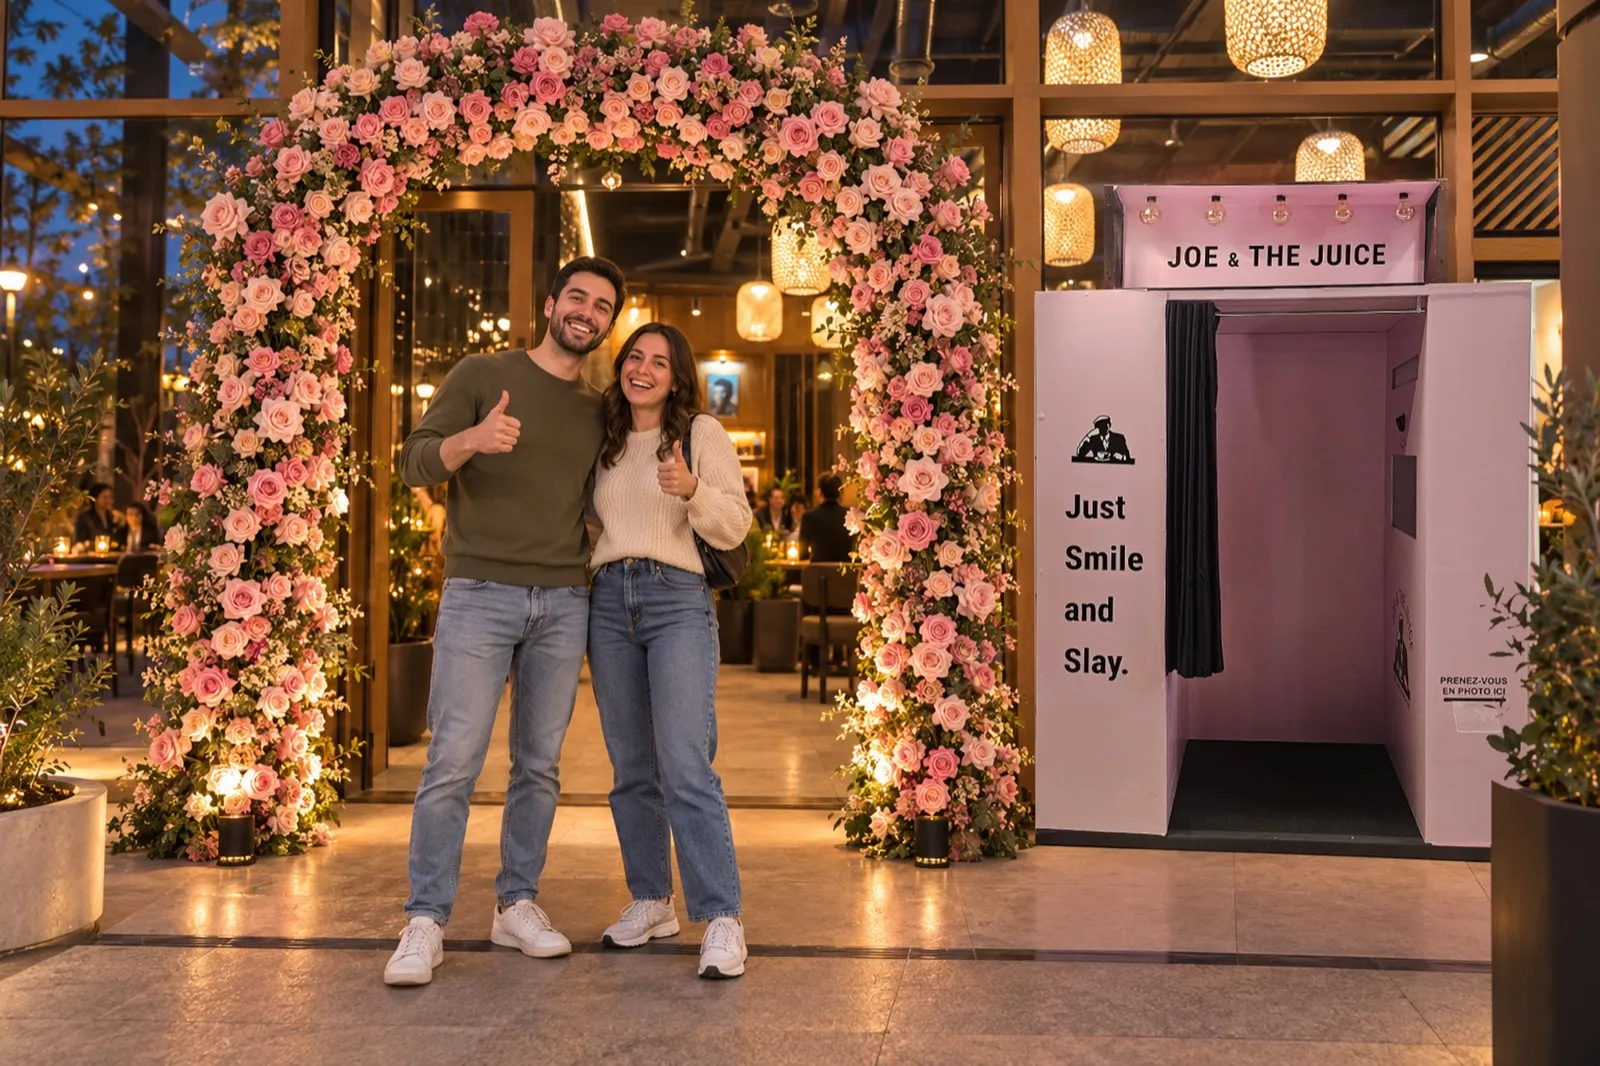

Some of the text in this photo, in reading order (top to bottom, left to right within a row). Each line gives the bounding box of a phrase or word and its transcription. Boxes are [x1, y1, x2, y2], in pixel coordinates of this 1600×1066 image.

[1167, 243, 1387, 268] JOE & THE JUICE
[1064, 493, 1126, 520] Just
[1064, 544, 1144, 572] Smile
[1064, 595, 1114, 623] and
[1063, 646, 1129, 682] Slay.
[1440, 676, 1508, 685] PRENEZ-VOUS
[1442, 687, 1506, 696] EN PHOTO ICI
